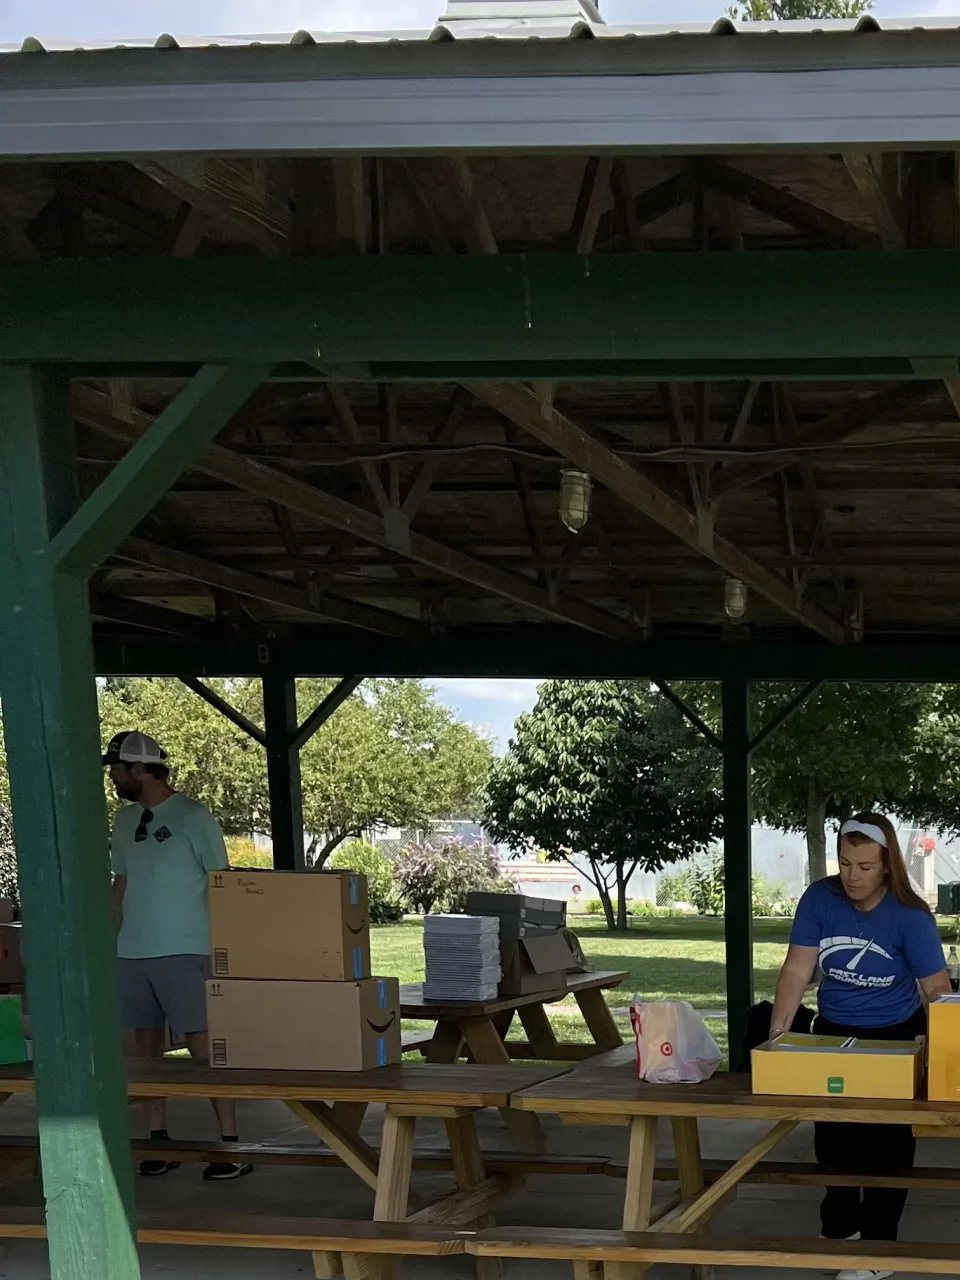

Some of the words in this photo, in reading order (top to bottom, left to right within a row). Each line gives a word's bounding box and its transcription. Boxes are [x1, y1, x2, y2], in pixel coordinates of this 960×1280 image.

[829, 968, 858, 978] FAST
[859, 974, 896, 983] LANE
[829, 973, 892, 988] FOUNDATION
